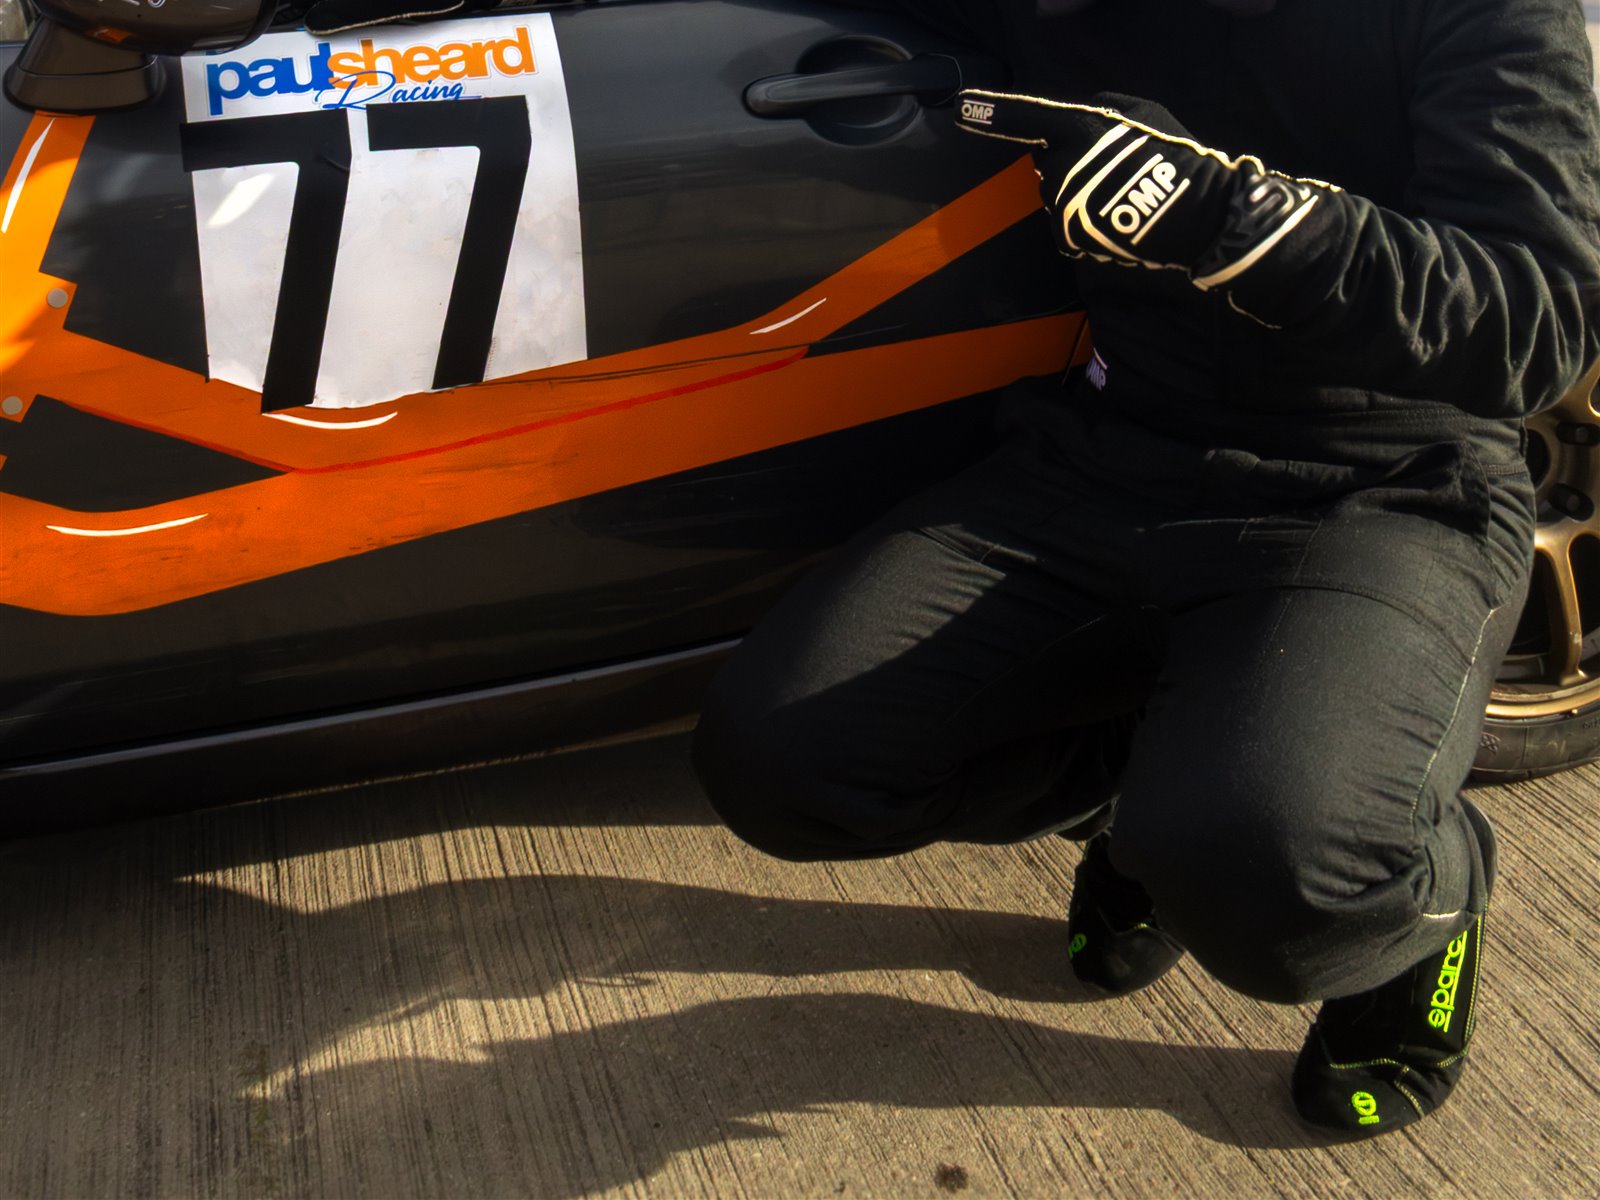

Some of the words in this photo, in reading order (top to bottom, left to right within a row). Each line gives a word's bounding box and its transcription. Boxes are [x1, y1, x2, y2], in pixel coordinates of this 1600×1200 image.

[313, 70, 482, 110] Racing
[961, 103, 994, 120] OMP
[1111, 162, 1177, 234] OMP
[180, 95, 532, 414] 77
[1428, 933, 1465, 1028] sparc
